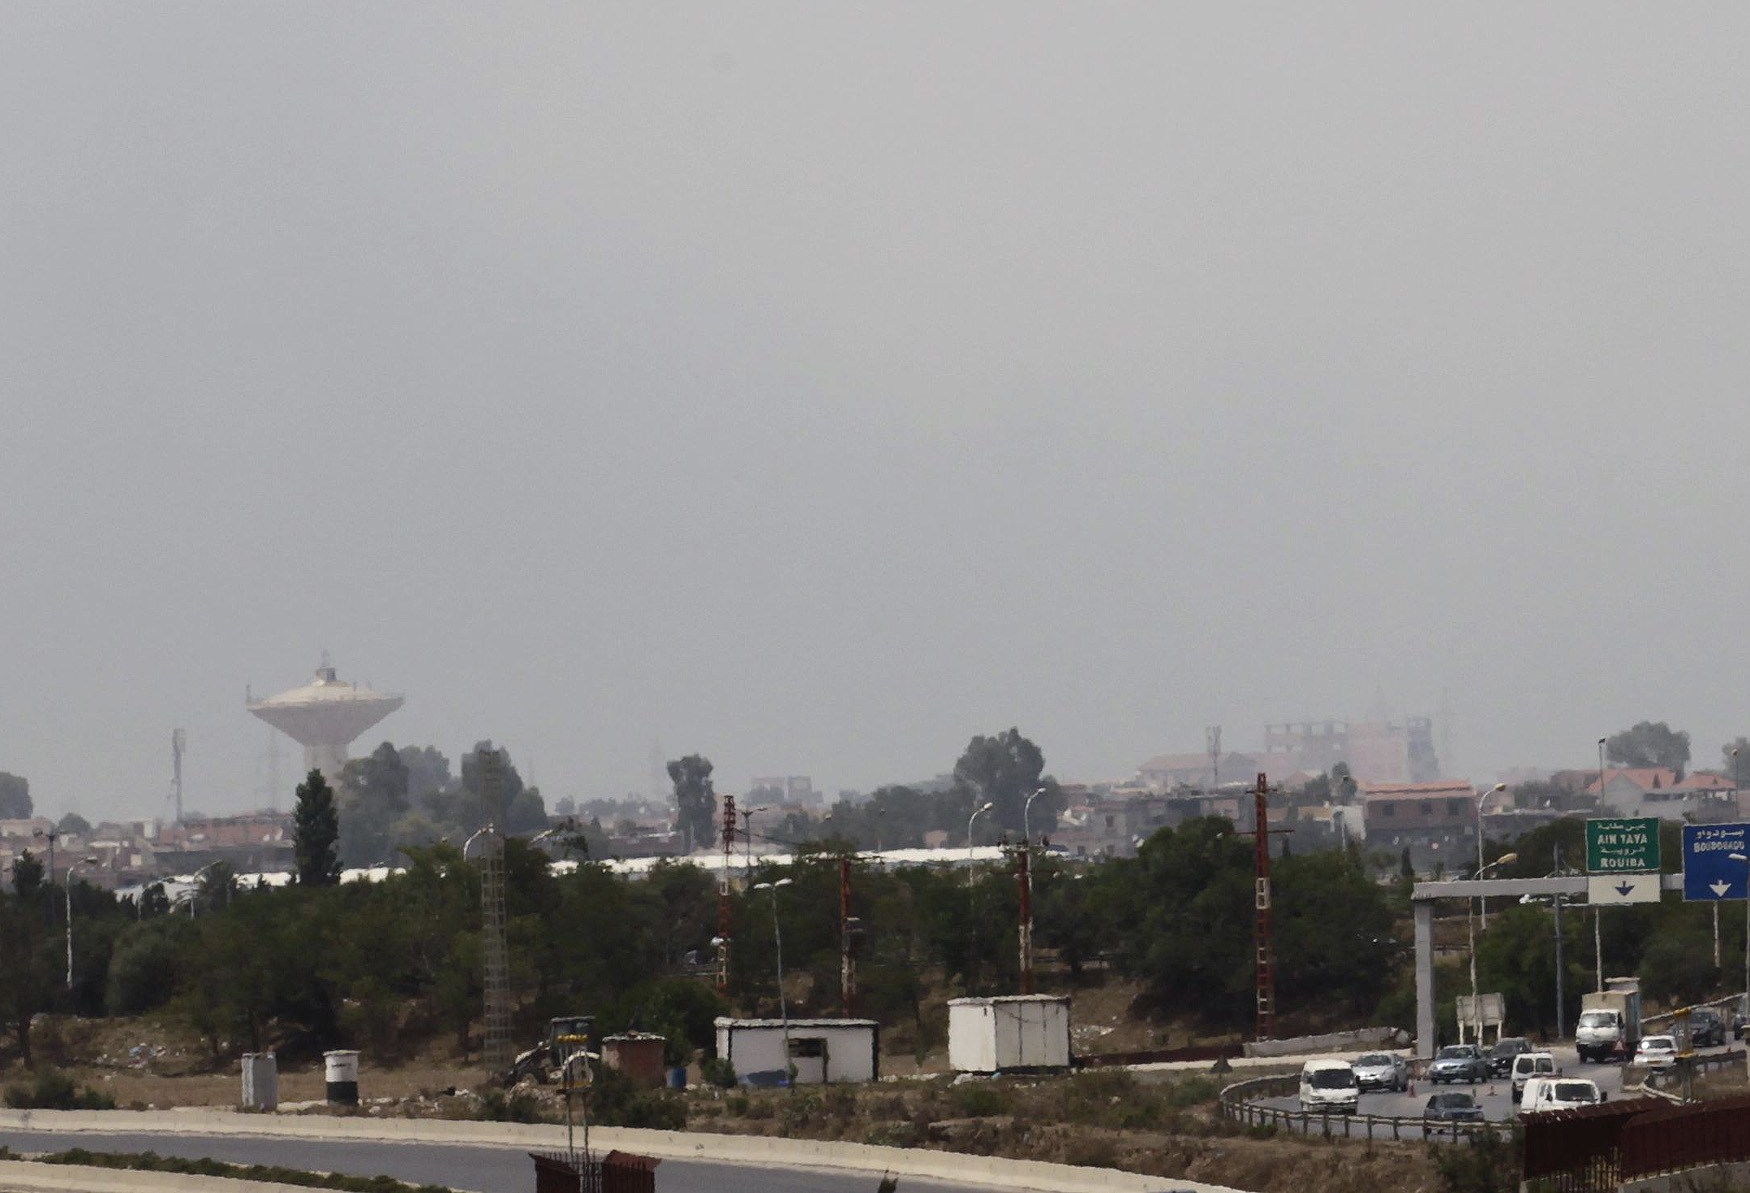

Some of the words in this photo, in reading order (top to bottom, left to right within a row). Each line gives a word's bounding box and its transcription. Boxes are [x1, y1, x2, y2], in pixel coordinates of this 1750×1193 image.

[1597, 834, 1617, 845] AIN
[1620, 833, 1648, 844] TAYA
[1600, 858, 1645, 868] ROUIBA
